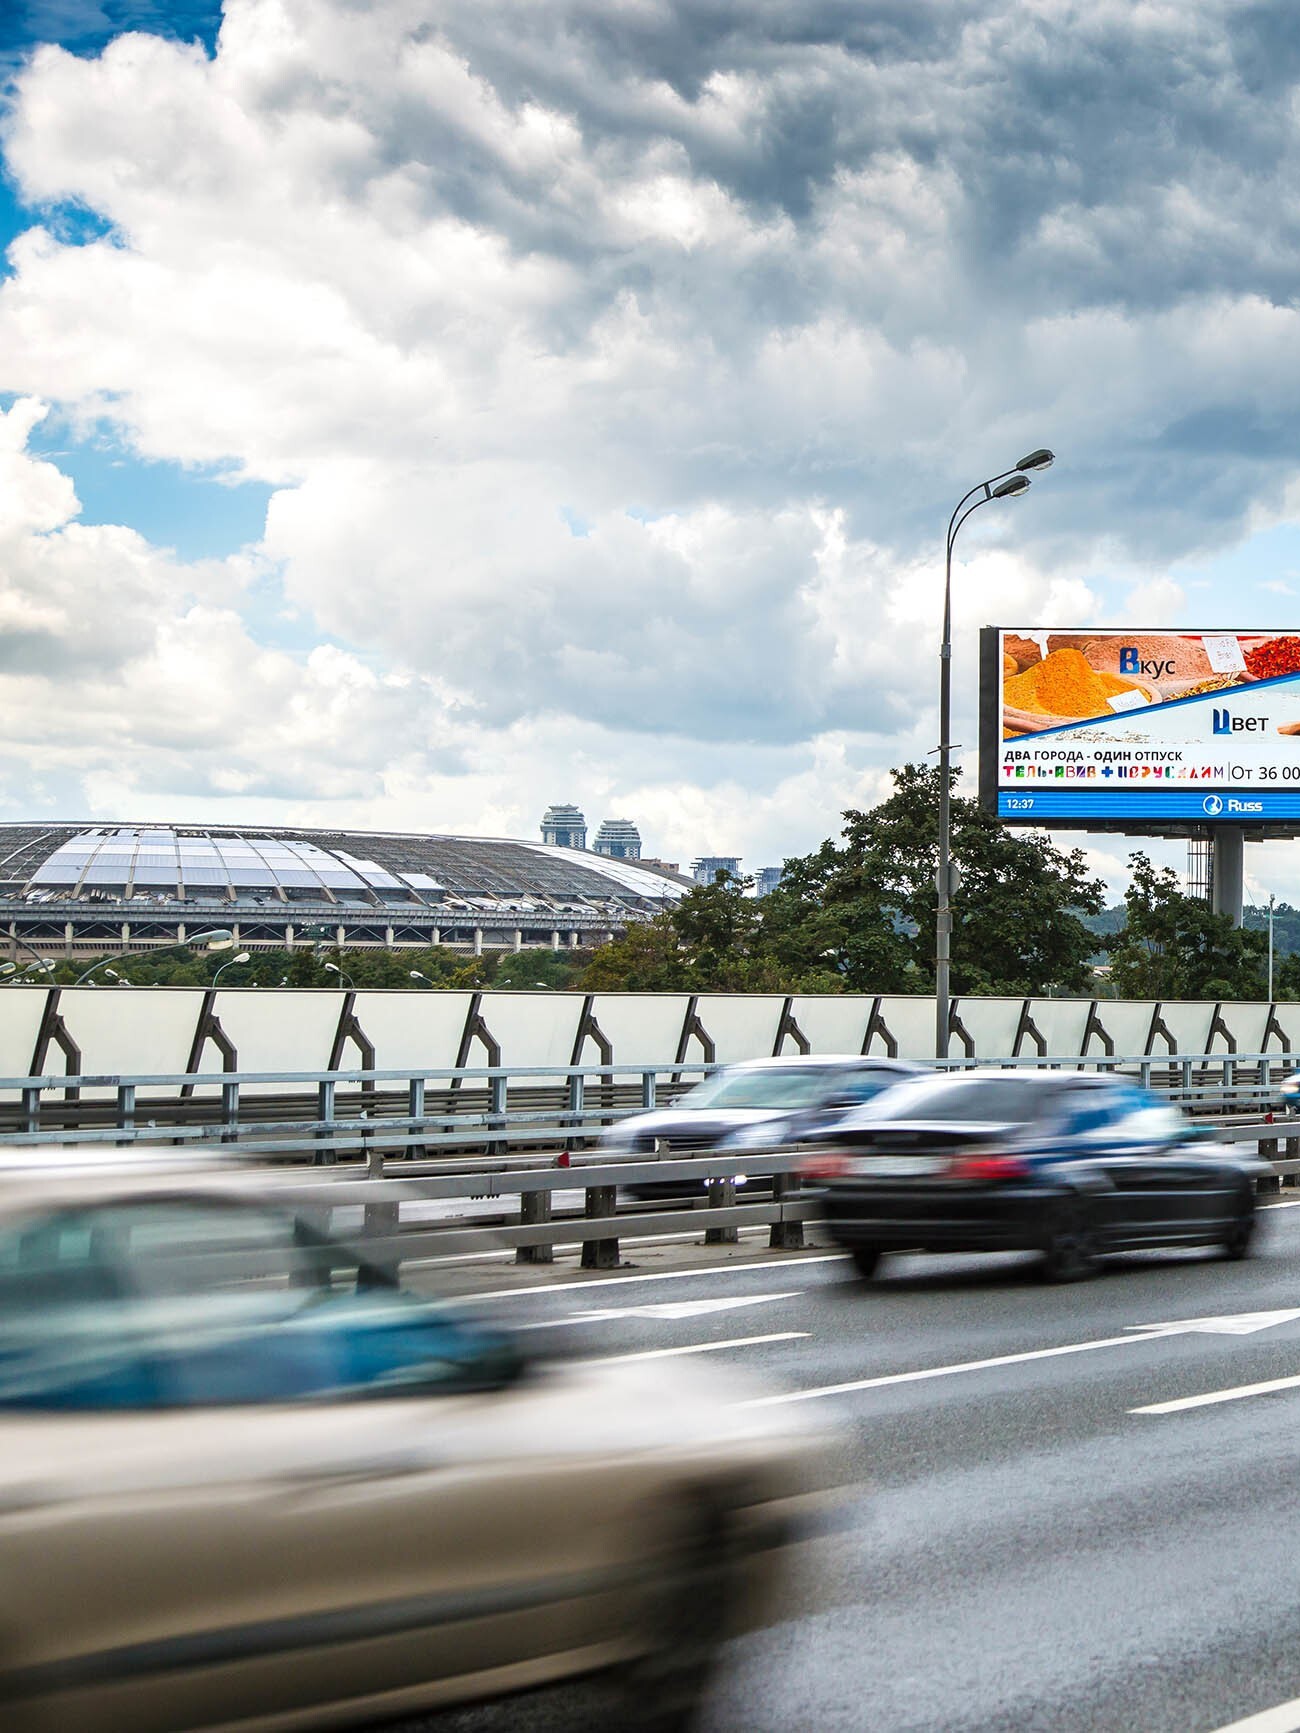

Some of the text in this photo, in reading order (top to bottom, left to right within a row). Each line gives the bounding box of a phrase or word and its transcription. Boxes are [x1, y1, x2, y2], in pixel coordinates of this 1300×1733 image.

[1120, 647, 1175, 679] Вкус
[1213, 708, 1269, 734] Цвет
[1004, 751, 1031, 762] ДВА
[1034, 751, 1084, 763] ГОРОДА
[1094, 751, 1131, 763] ОДИН
[1134, 751, 1183, 761] ОТПУСК
[1231, 766, 1253, 779] От
[1258, 766, 1278, 780] 36
[1007, 799, 1034, 809] 12:37
[1228, 799, 1264, 812] Russ
